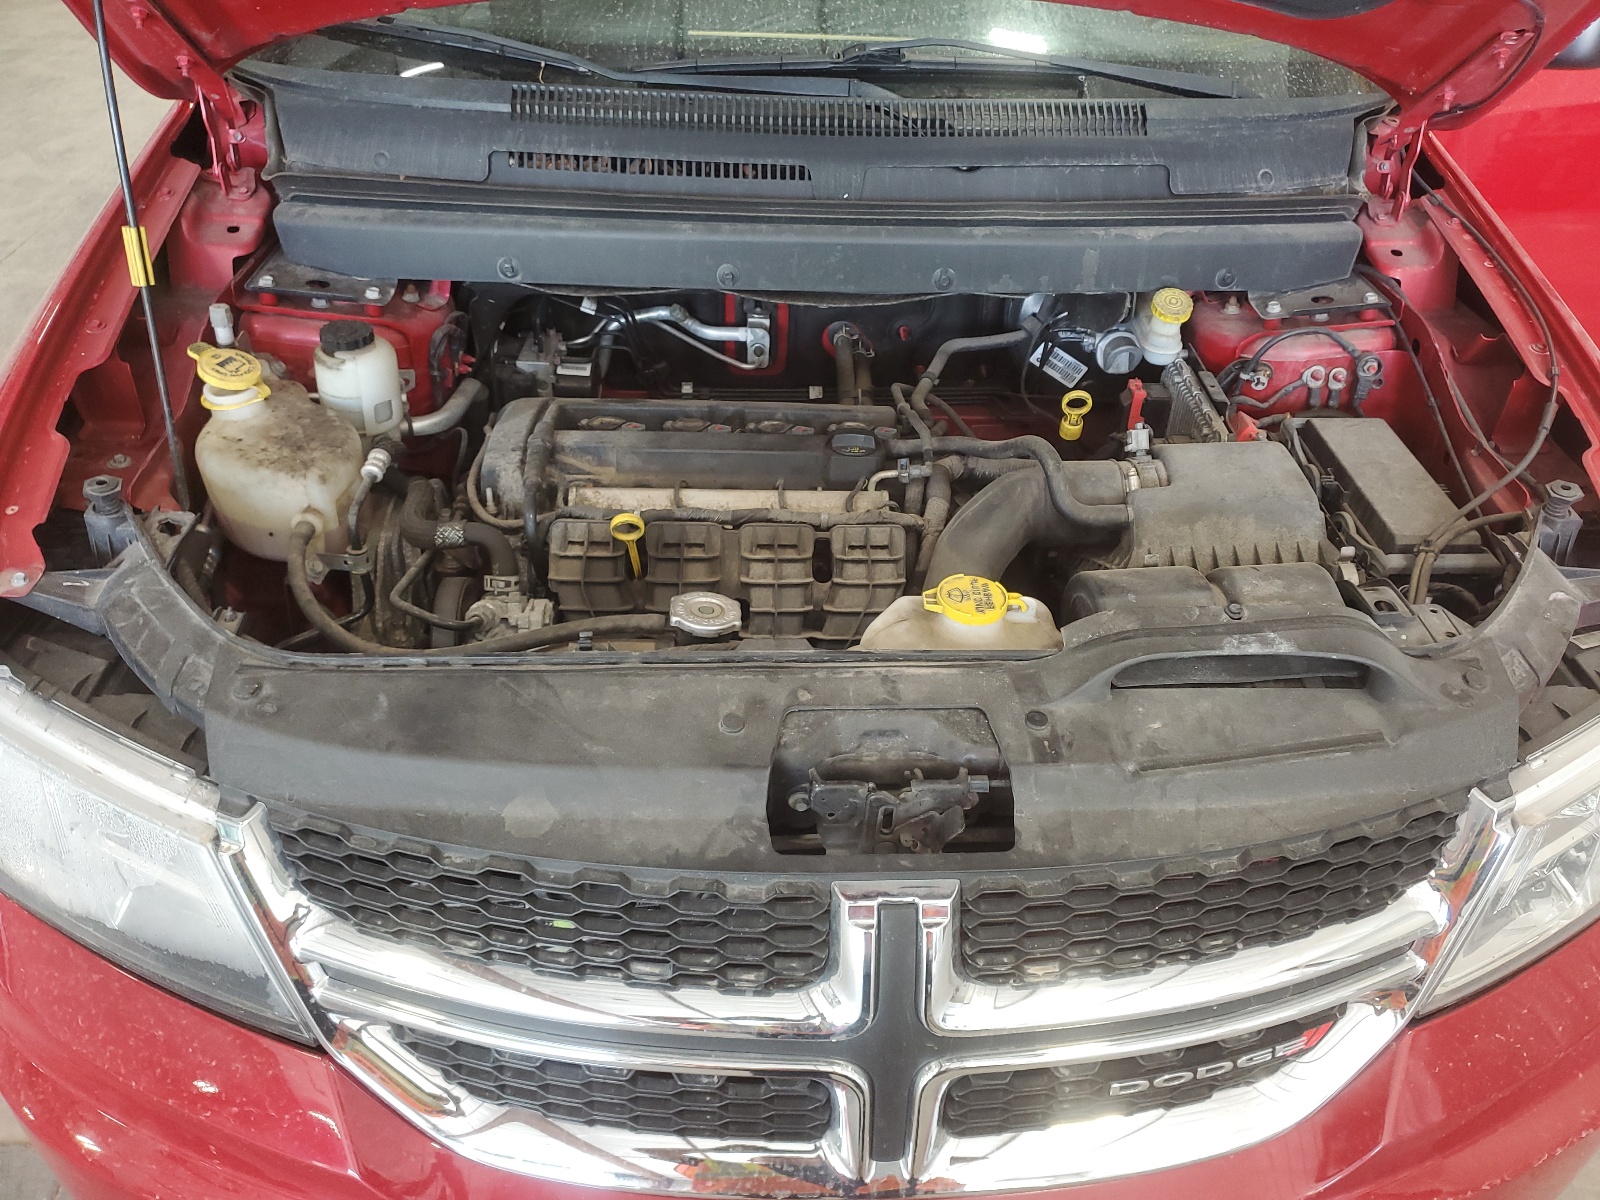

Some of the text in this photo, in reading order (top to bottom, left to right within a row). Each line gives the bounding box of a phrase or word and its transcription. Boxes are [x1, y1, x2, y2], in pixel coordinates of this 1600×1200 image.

[970, 578, 985, 614] FLUID ONLY
[981, 582, 995, 610] WASHER
[1109, 1036, 1308, 1096] DODGE
